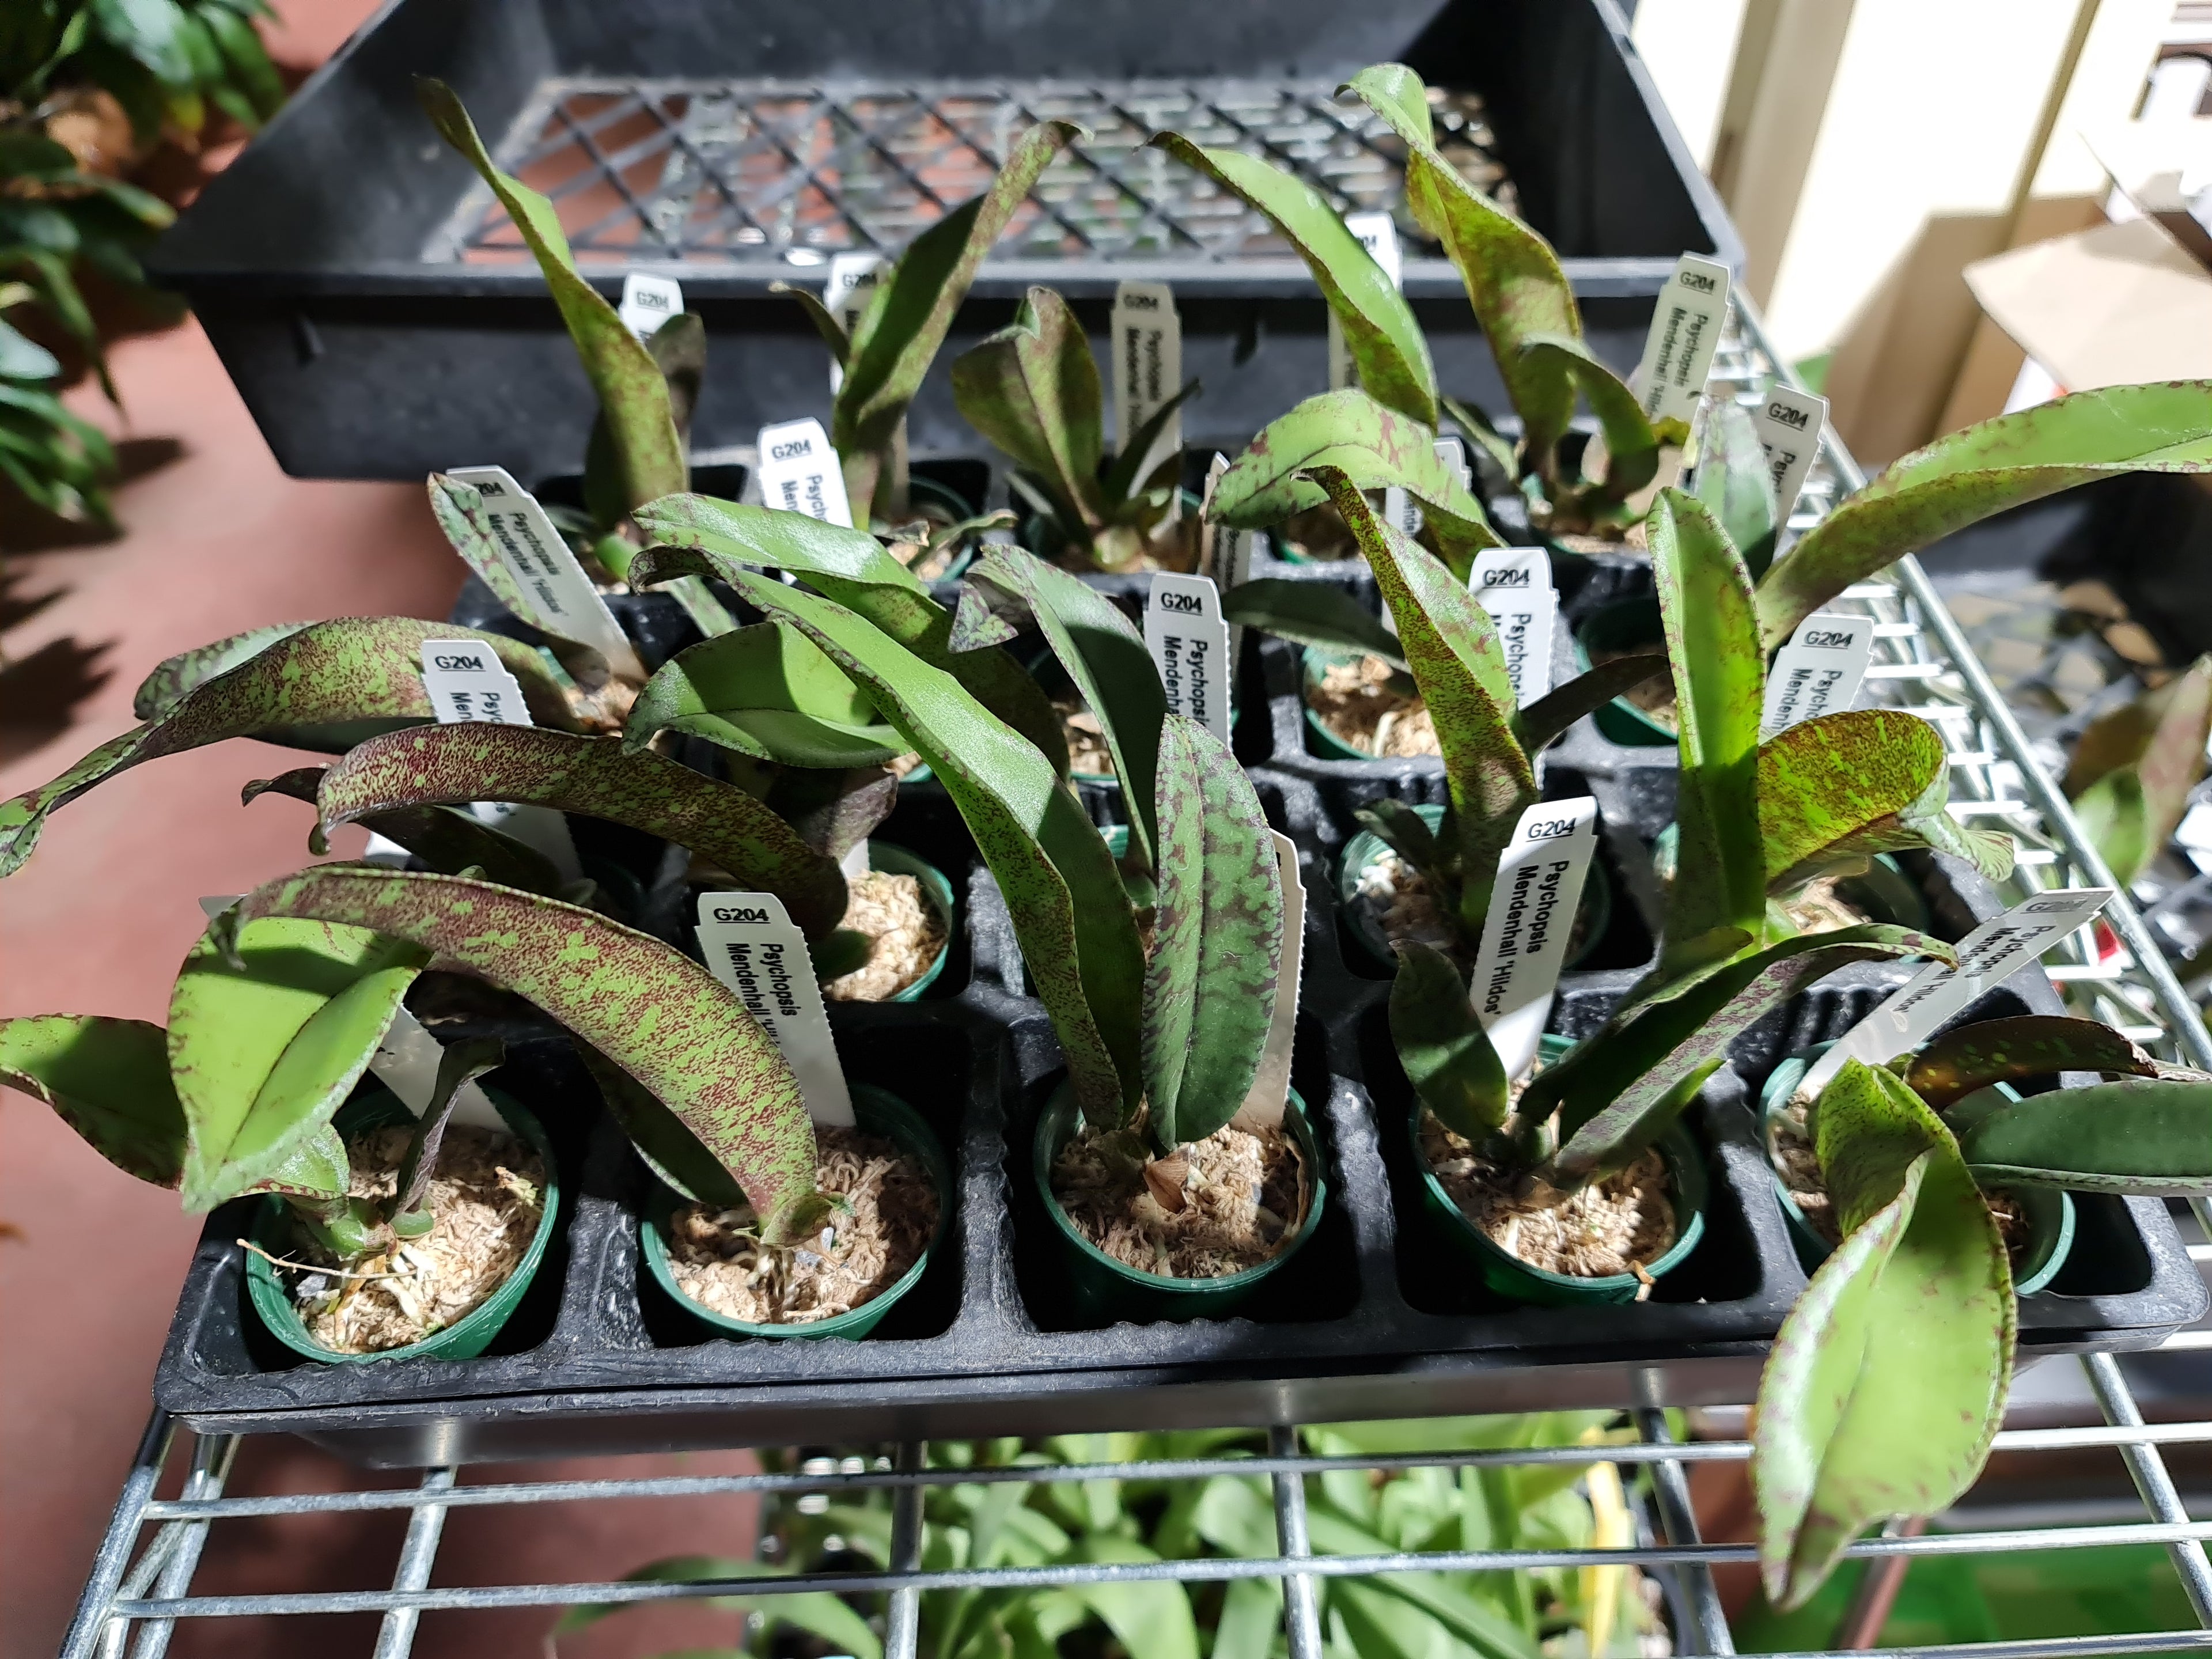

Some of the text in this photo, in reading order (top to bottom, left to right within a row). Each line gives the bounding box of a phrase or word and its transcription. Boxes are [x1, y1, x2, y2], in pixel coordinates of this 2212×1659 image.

[1679, 271, 1715, 290] G204
[1768, 402, 1809, 428] G204
[772, 440, 812, 459] G204
[1483, 569, 1529, 586] G204
[1161, 592, 1202, 613] G204
[1804, 631, 1854, 647] G204
[434, 656, 484, 669] G204
[1186, 638, 1210, 726] Psychopsi
[1797, 670, 1843, 722] Psycho
[1528, 818, 1576, 839] G204
[714, 908, 770, 922] G204
[1526, 860, 1570, 954] Psychopsis
[1484, 865, 1539, 1014] Mendenhall 'Hildos'
[1964, 925, 2057, 978] Psychopsis
[1931, 927, 2021, 980] Mendenall
[726, 943, 771, 1015] Mendenhall
[760, 943, 801, 1017] Psychopsis
